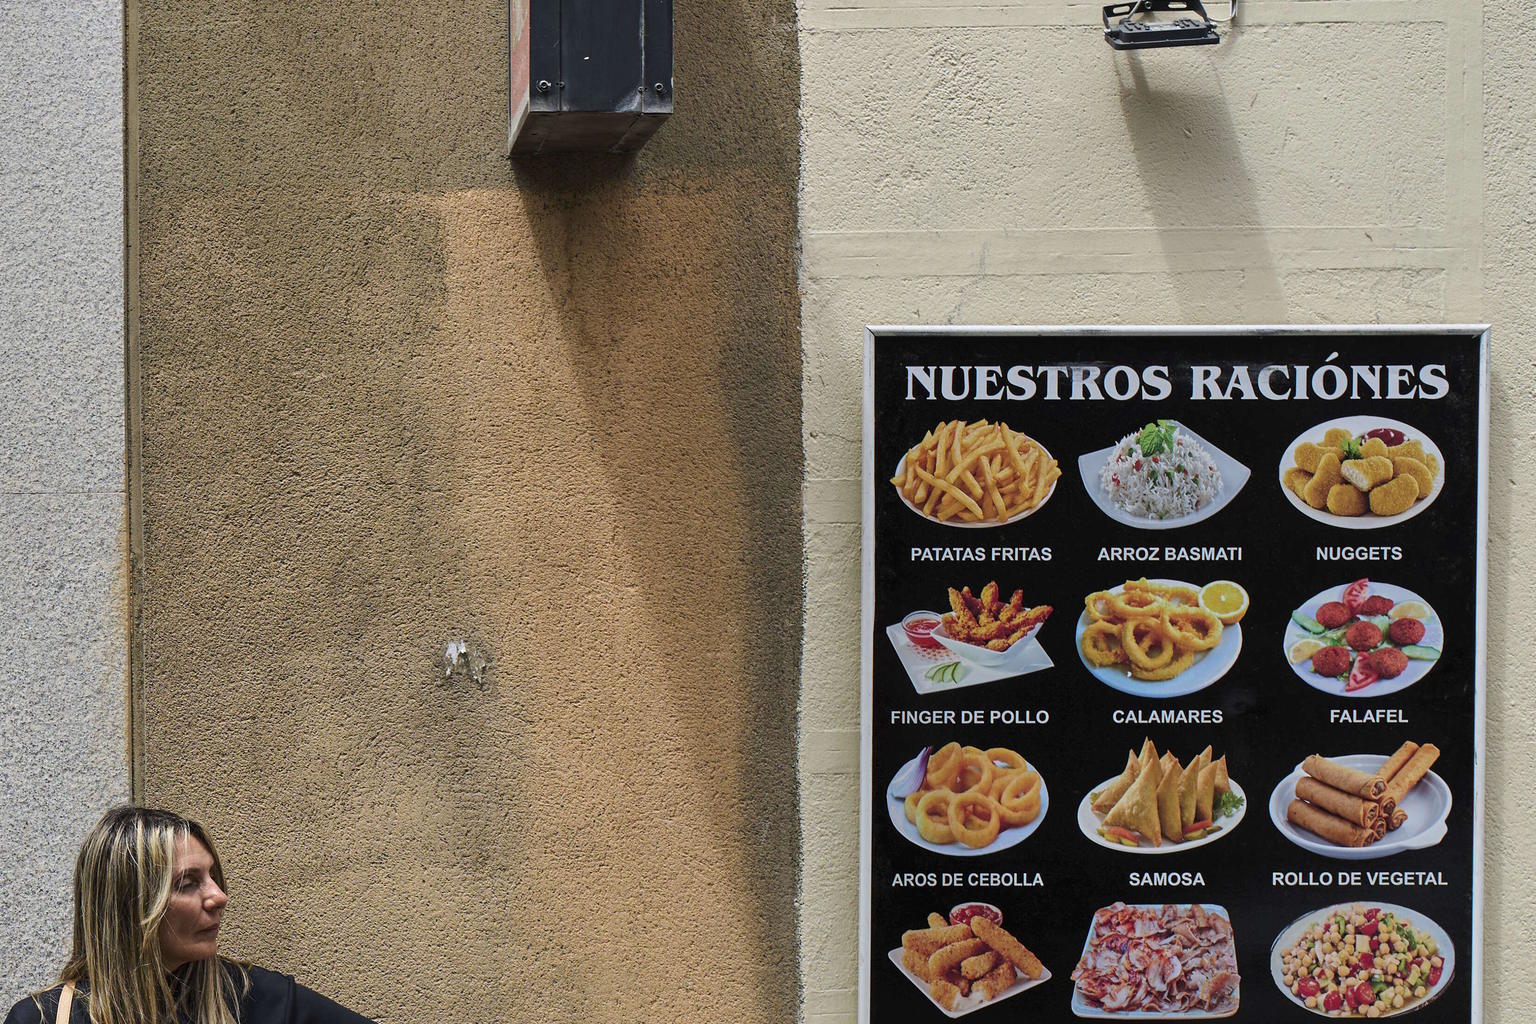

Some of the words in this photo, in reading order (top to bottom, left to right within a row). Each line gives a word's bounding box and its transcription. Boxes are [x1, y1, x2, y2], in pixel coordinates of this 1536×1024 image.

[904, 365, 1173, 401] NUESTROS
[1189, 351, 1450, 401] RACIÓNES
[911, 547, 986, 562] PATATAS
[991, 547, 1053, 562] FRITAS
[1097, 546, 1160, 561] ARROZ
[1164, 546, 1242, 561] BASMATI
[1316, 546, 1403, 561] NUGGETS
[891, 710, 956, 725] FINGER
[961, 710, 985, 724] DE
[990, 709, 1050, 725] POLLO
[1112, 709, 1224, 724] CALAMARES
[1330, 709, 1409, 724] FALAFEL
[891, 872, 938, 887] AROS
[942, 872, 964, 887] DE
[967, 872, 1044, 887] CEBOLLA
[1128, 872, 1206, 887] SAMOSA
[1272, 871, 1333, 886] ROLLO
[1338, 871, 1362, 886] DE
[1366, 871, 1449, 886] VEGETAL
